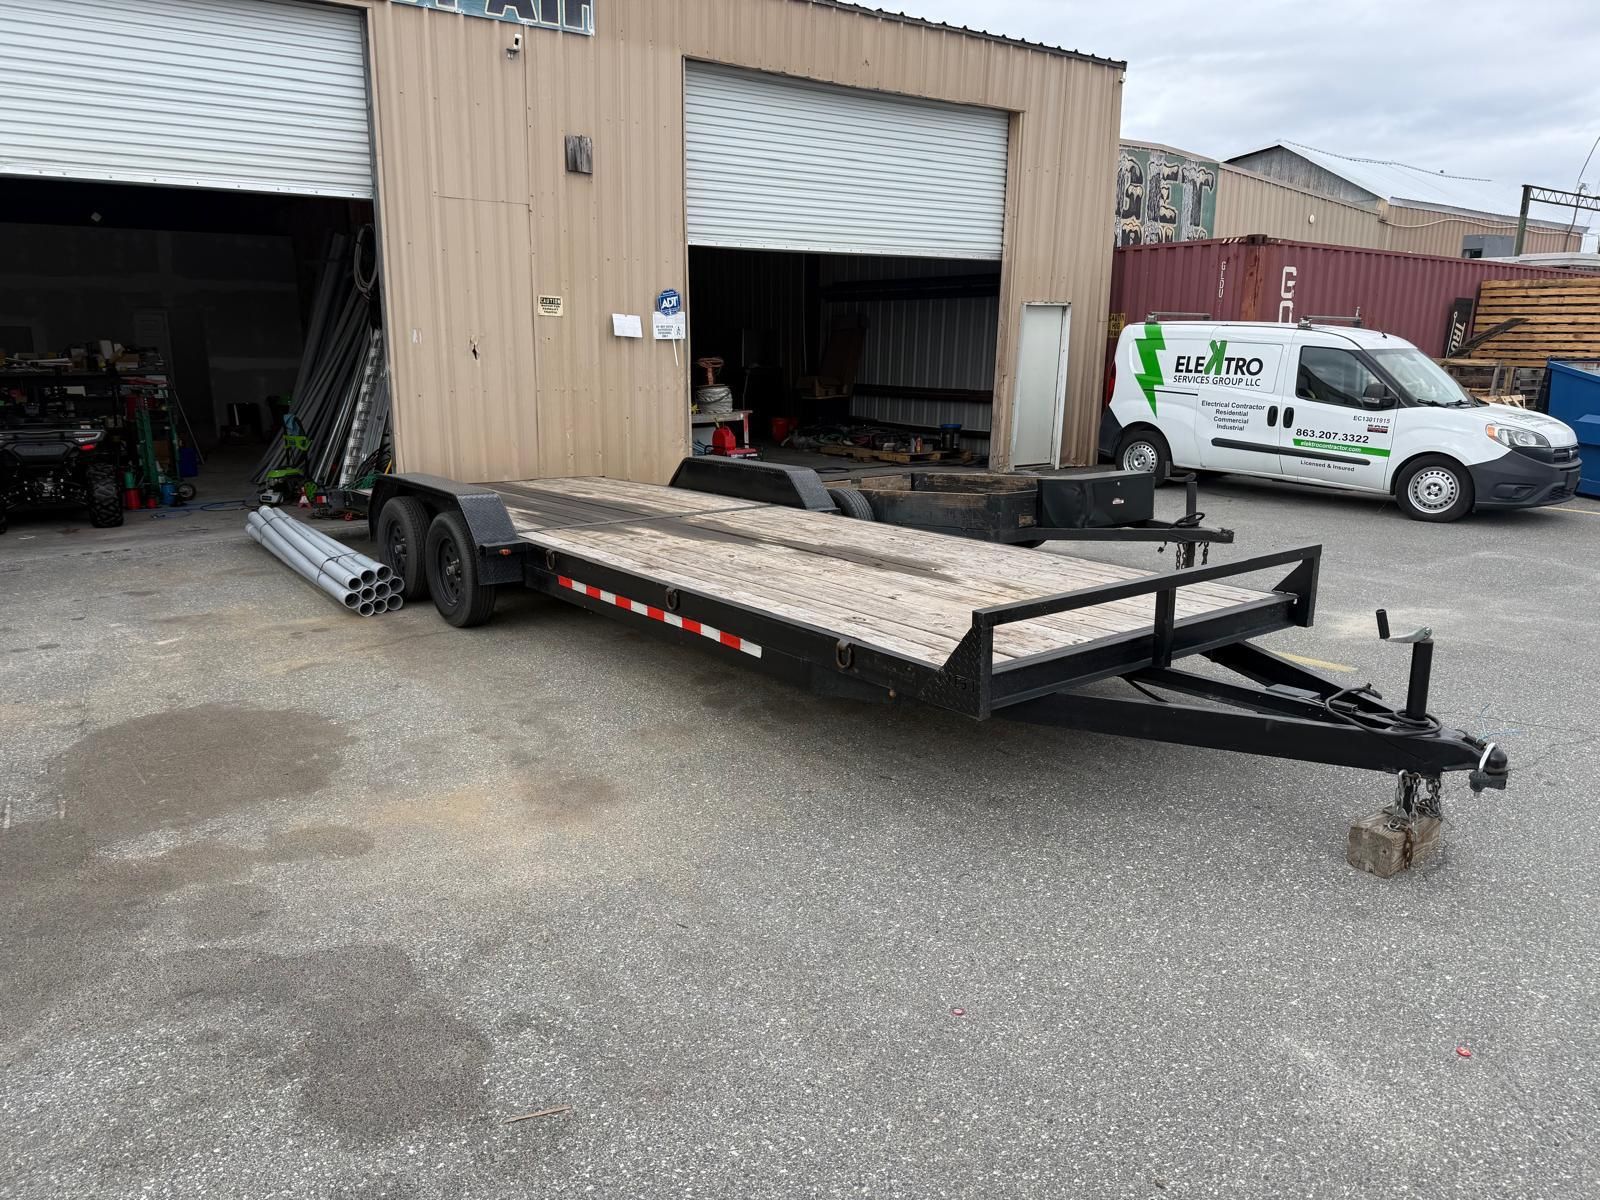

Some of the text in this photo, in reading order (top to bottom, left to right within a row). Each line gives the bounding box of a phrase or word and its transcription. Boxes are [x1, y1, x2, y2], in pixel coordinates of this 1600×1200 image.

[661, 296, 679, 309] ADT
[1174, 340, 1264, 376] ELEKTRO
[1173, 375, 1261, 387] SERVICES GROUP LLC
[1201, 400, 1266, 411] Electrical Contractor
[1215, 408, 1249, 417] Residential
[1213, 416, 1249, 424] Commercial
[1216, 423, 1245, 431] Industrial
[1295, 428, 1369, 444] 863.207.3322
[1300, 440, 1362, 453] elektrocontractor.com
[1300, 460, 1326, 468] Licensed
[1333, 464, 1355, 472] Insured
